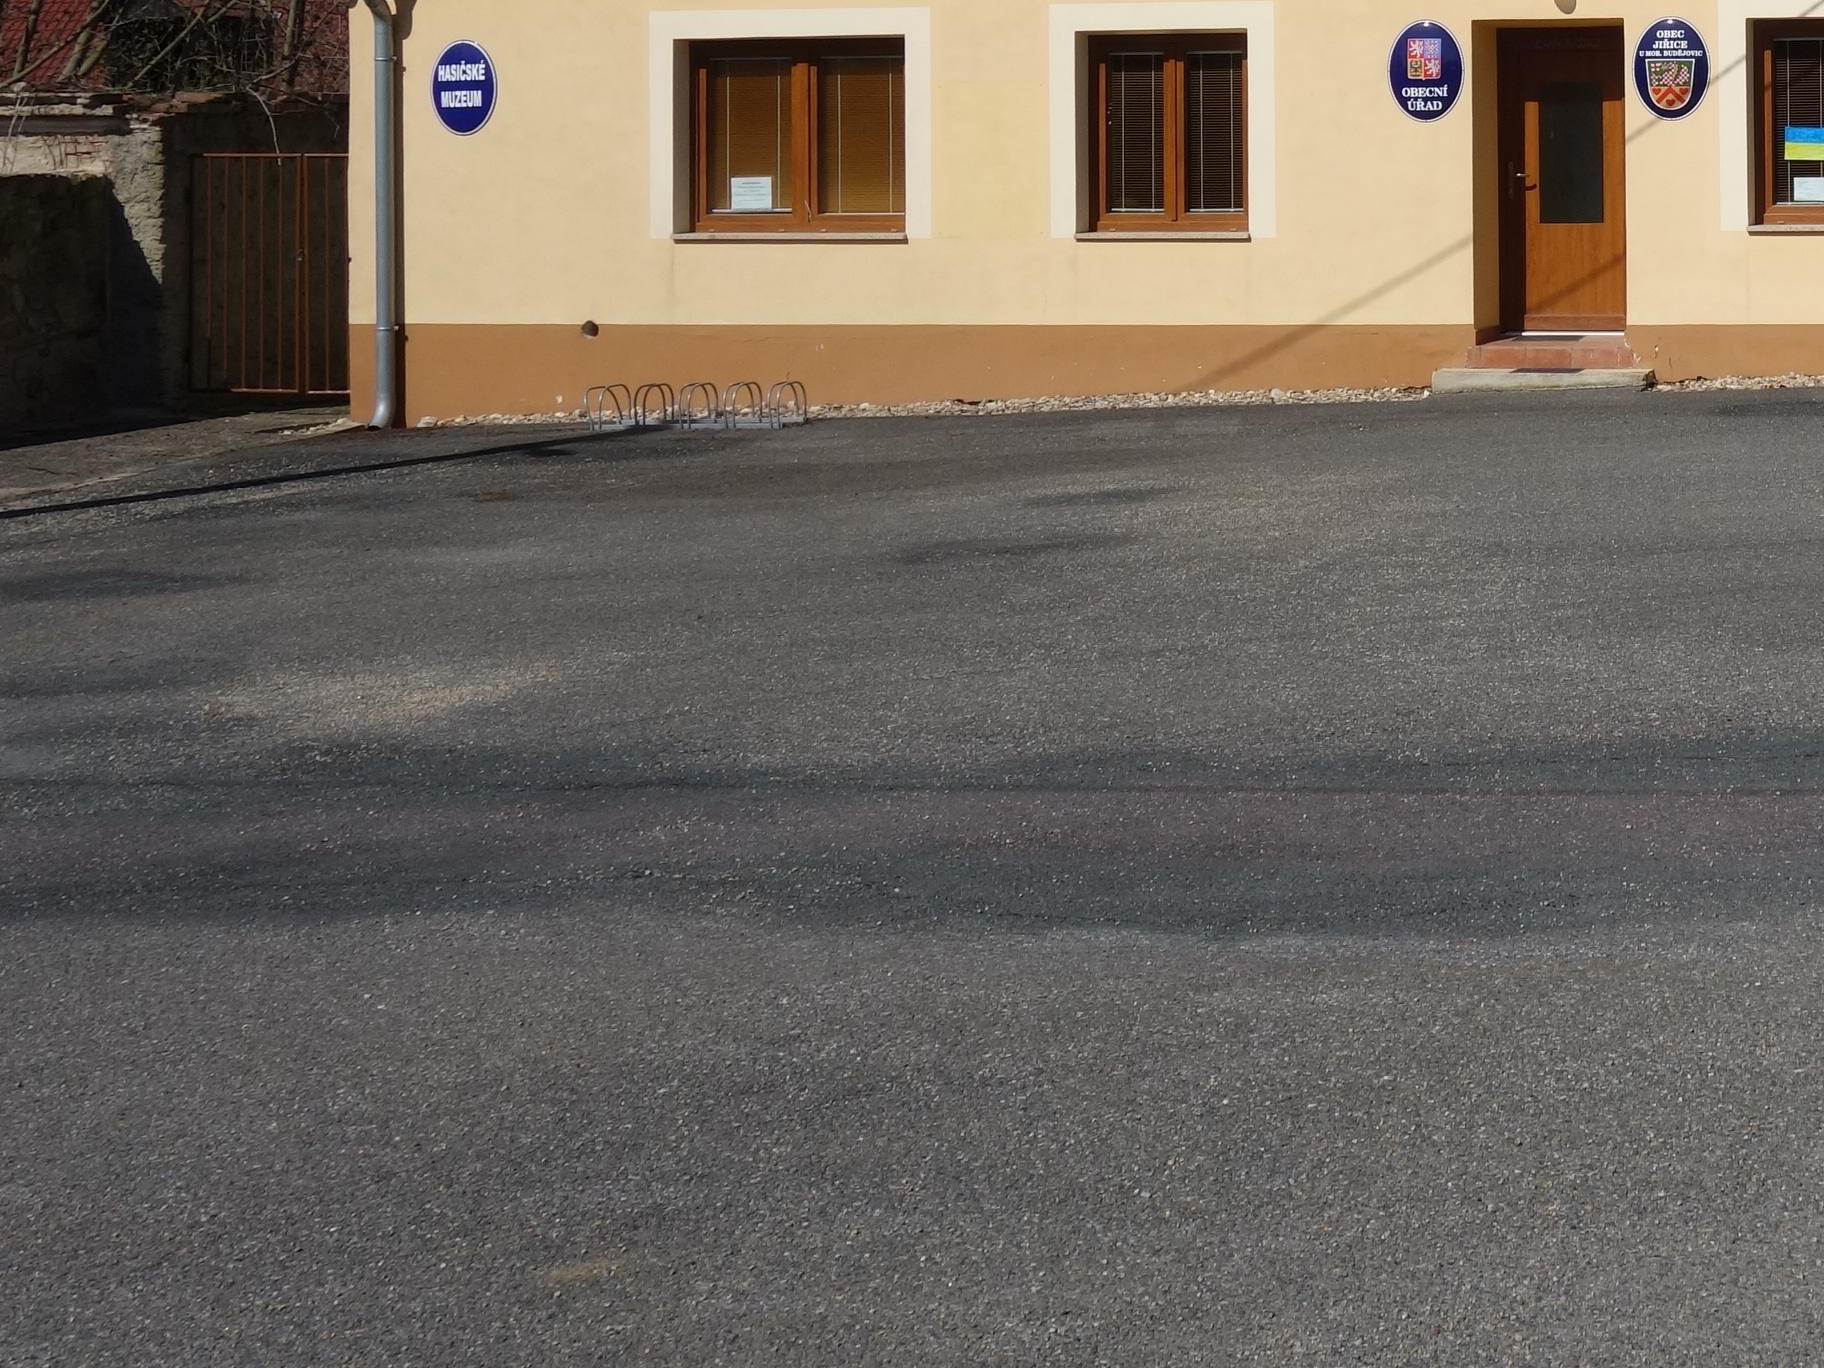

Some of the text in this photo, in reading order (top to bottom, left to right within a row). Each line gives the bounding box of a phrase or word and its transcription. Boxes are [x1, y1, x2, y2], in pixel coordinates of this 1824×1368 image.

[1656, 29, 1685, 38] OBEC
[1652, 38, 1688, 49] JIŘICE
[1663, 48, 1703, 57] BUDĚJOVIC
[438, 59, 486, 82] HASIČSKÉ
[1401, 84, 1448, 97] OBECNÍ
[441, 90, 482, 108] MUZEUM
[1406, 98, 1443, 111] ÚŘAD
